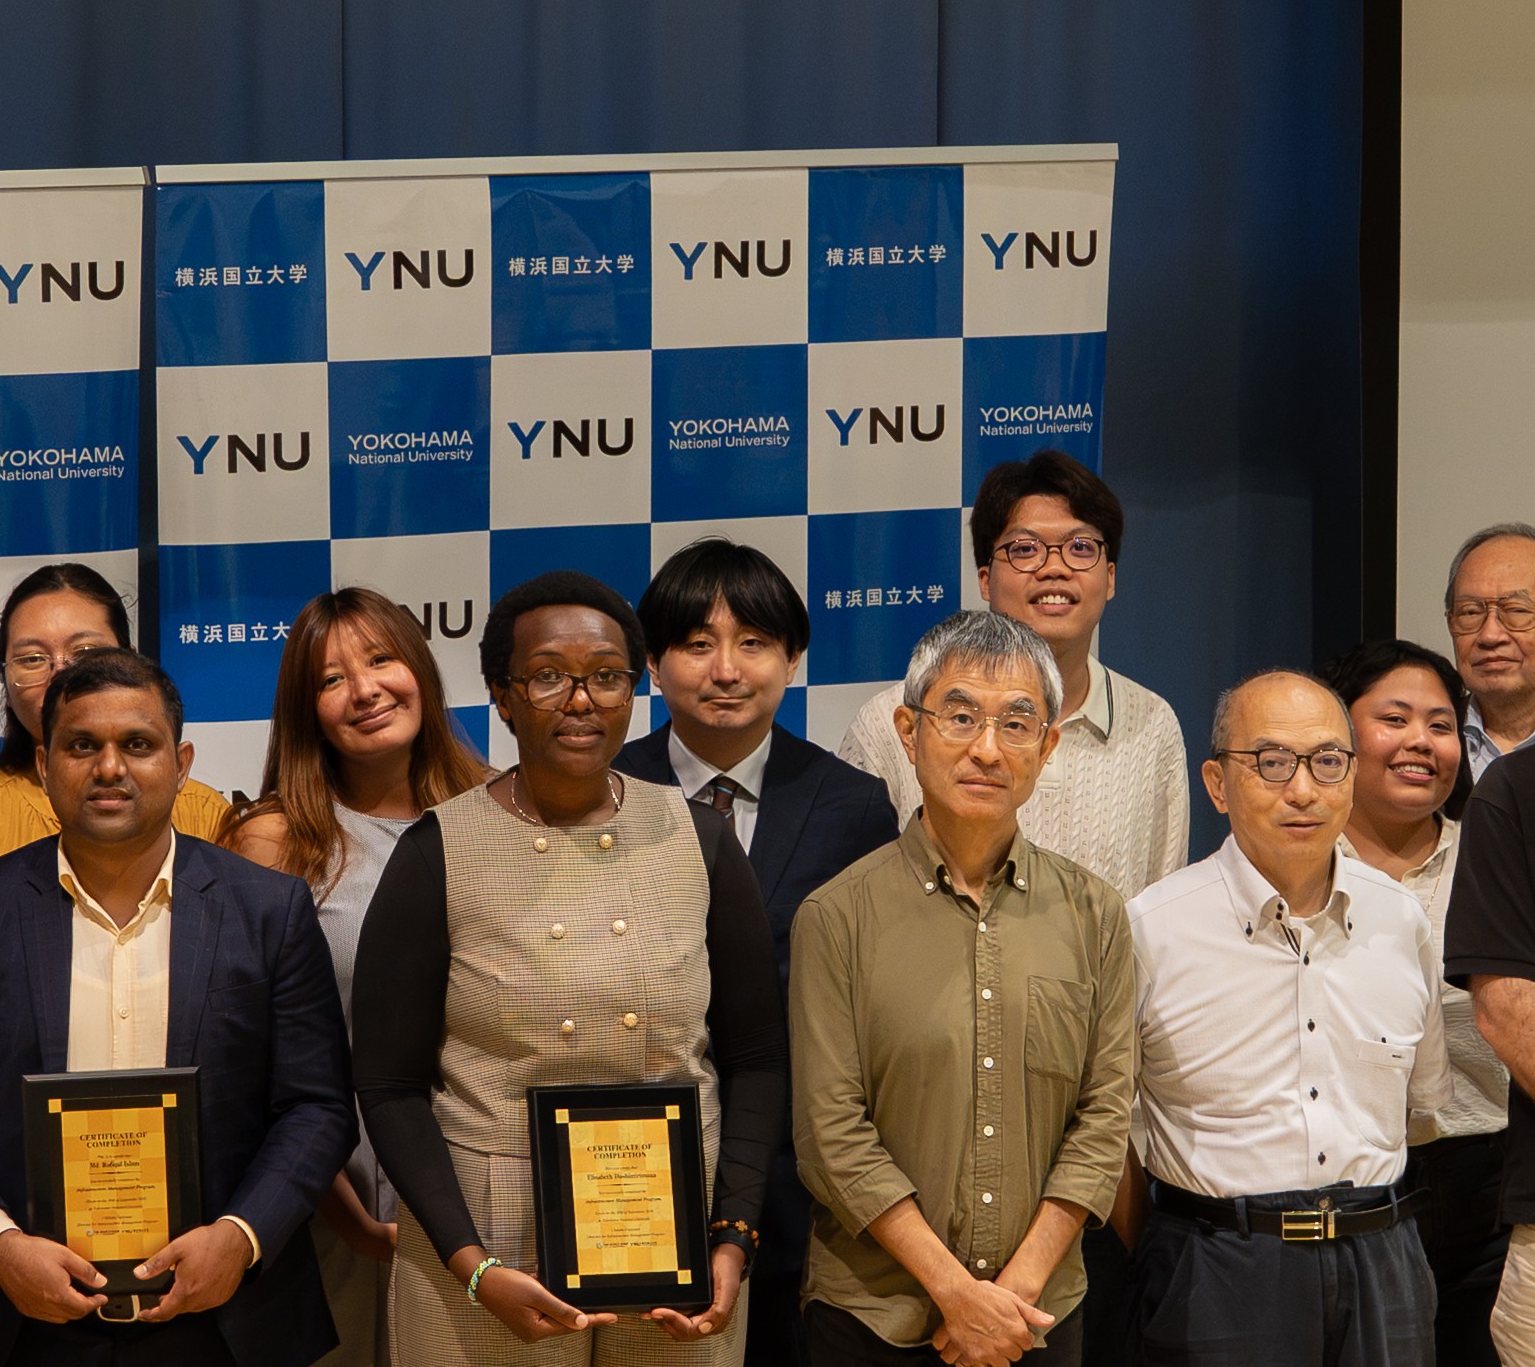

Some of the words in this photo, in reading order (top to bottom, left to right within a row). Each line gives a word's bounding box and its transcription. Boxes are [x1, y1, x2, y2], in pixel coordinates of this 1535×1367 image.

[670, 239, 790, 280] YNU
[826, 245, 947, 266] 横浜国立大学
[981, 230, 1096, 270] YNU
[176, 264, 307, 287] 横浜国立大学
[344, 249, 473, 290] YNU
[509, 255, 634, 276] 横浜国立大学
[980, 403, 1093, 423] YOKOHAMA
[669, 415, 789, 436] YOKOHAMA
[826, 404, 945, 445] YNU
[980, 423, 1029, 436] National
[1033, 419, 1093, 434] University
[348, 430, 473, 450] YOKOHAMA
[508, 418, 633, 459] YNU
[669, 436, 721, 450] National
[725, 432, 789, 448] University
[177, 432, 310, 475] YNU
[349, 450, 403, 465] National
[408, 447, 473, 462] University
[58, 463, 124, 480] University
[825, 585, 944, 608] 横浜国立大学
[180, 622, 290, 644] 横浜国立大
[80, 1132, 135, 1141] CERTIFICATE
[87, 1140, 141, 1148] COMPLETION
[587, 1144, 640, 1152] CERTIFICATE
